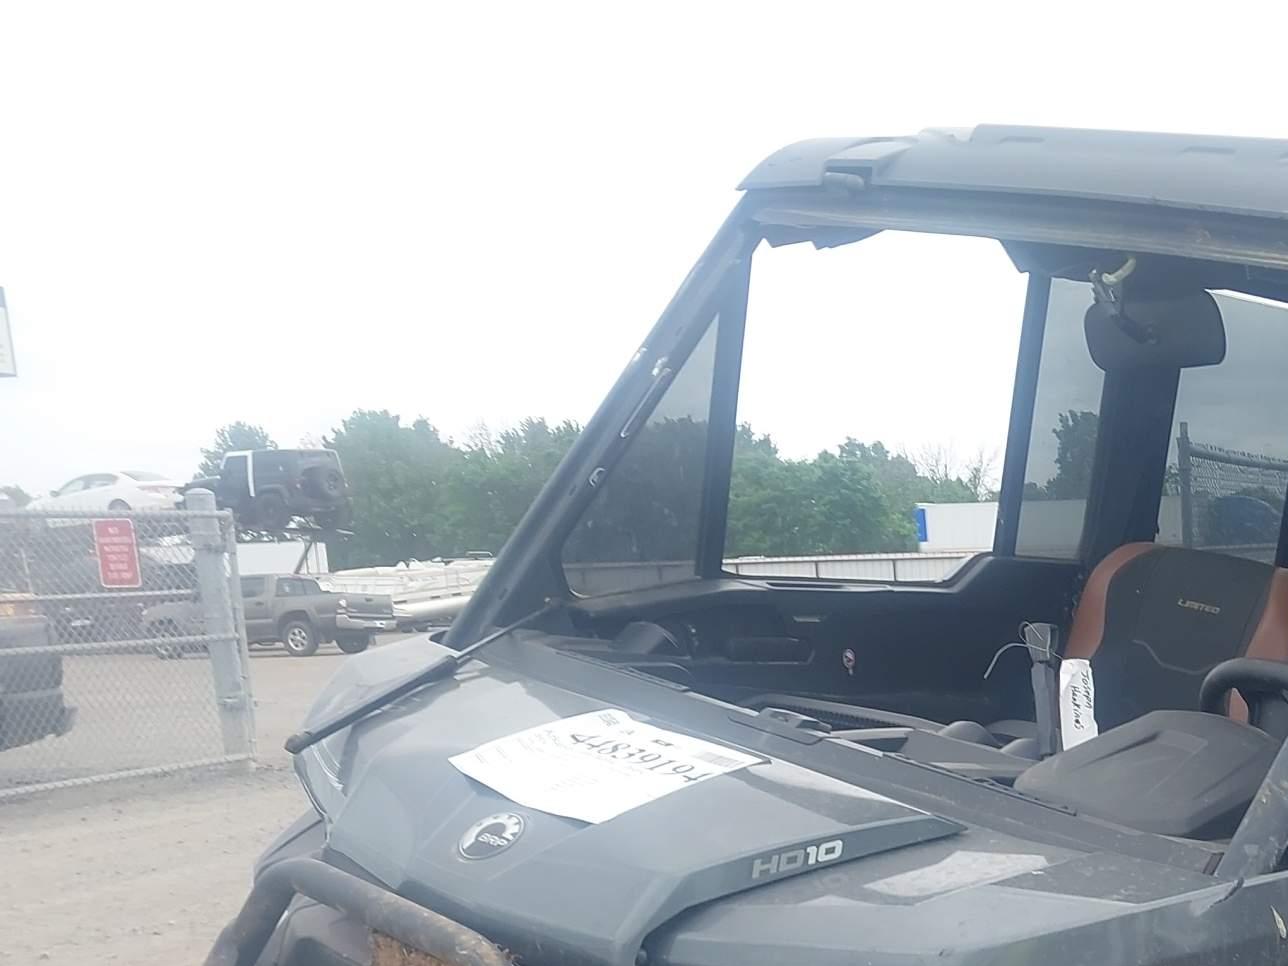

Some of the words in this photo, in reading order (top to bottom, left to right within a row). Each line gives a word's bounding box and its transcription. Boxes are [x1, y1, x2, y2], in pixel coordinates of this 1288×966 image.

[569, 733, 714, 783] 44839194
[477, 832, 508, 847] BRP
[751, 839, 843, 879] HD10
